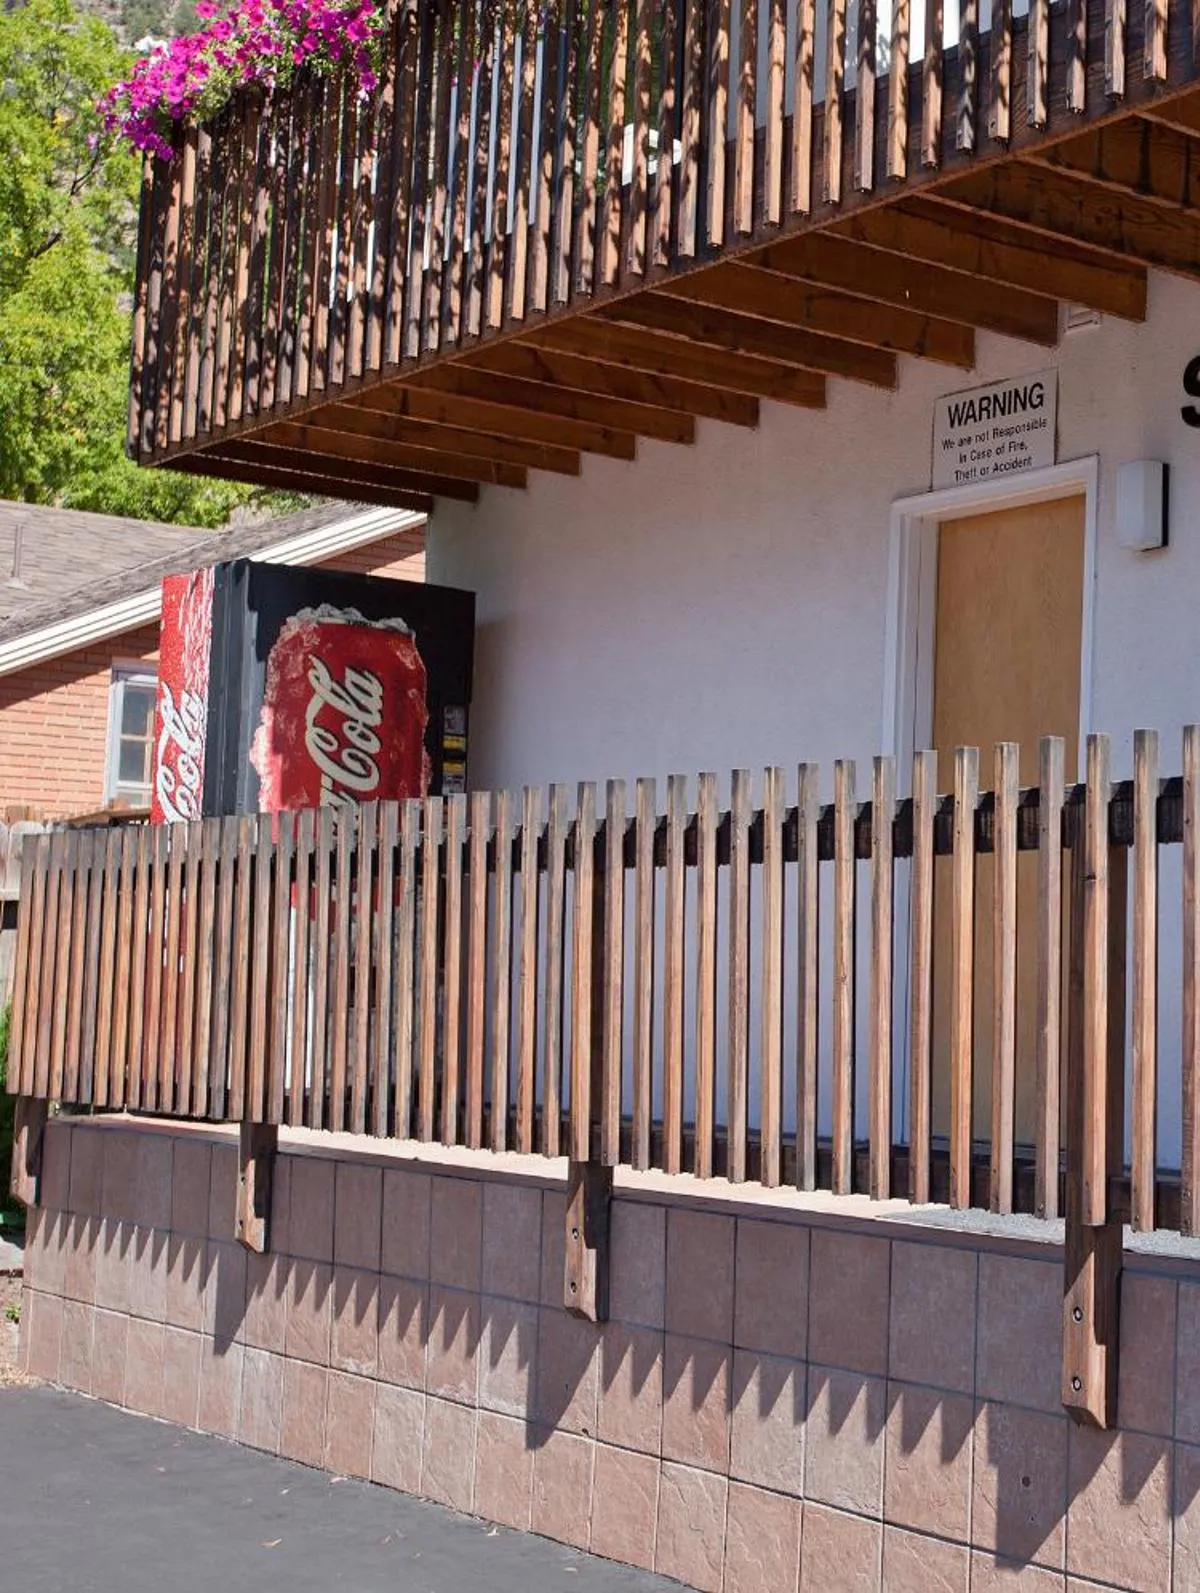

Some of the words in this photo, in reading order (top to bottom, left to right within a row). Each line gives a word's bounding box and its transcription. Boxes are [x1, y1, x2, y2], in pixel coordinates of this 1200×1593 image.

[947, 382, 1044, 428] WARNING
[942, 438, 955, 450] We
[957, 435, 972, 447] are
[975, 432, 989, 444] not
[993, 417, 1047, 440] Responsible
[954, 467, 977, 481] Theft
[980, 466, 990, 477] or
[993, 456, 1033, 473] Accident
[959, 452, 967, 464] In
[970, 447, 992, 461] Case
[996, 443, 1004, 456] of
[305, 654, 386, 792] Cola
